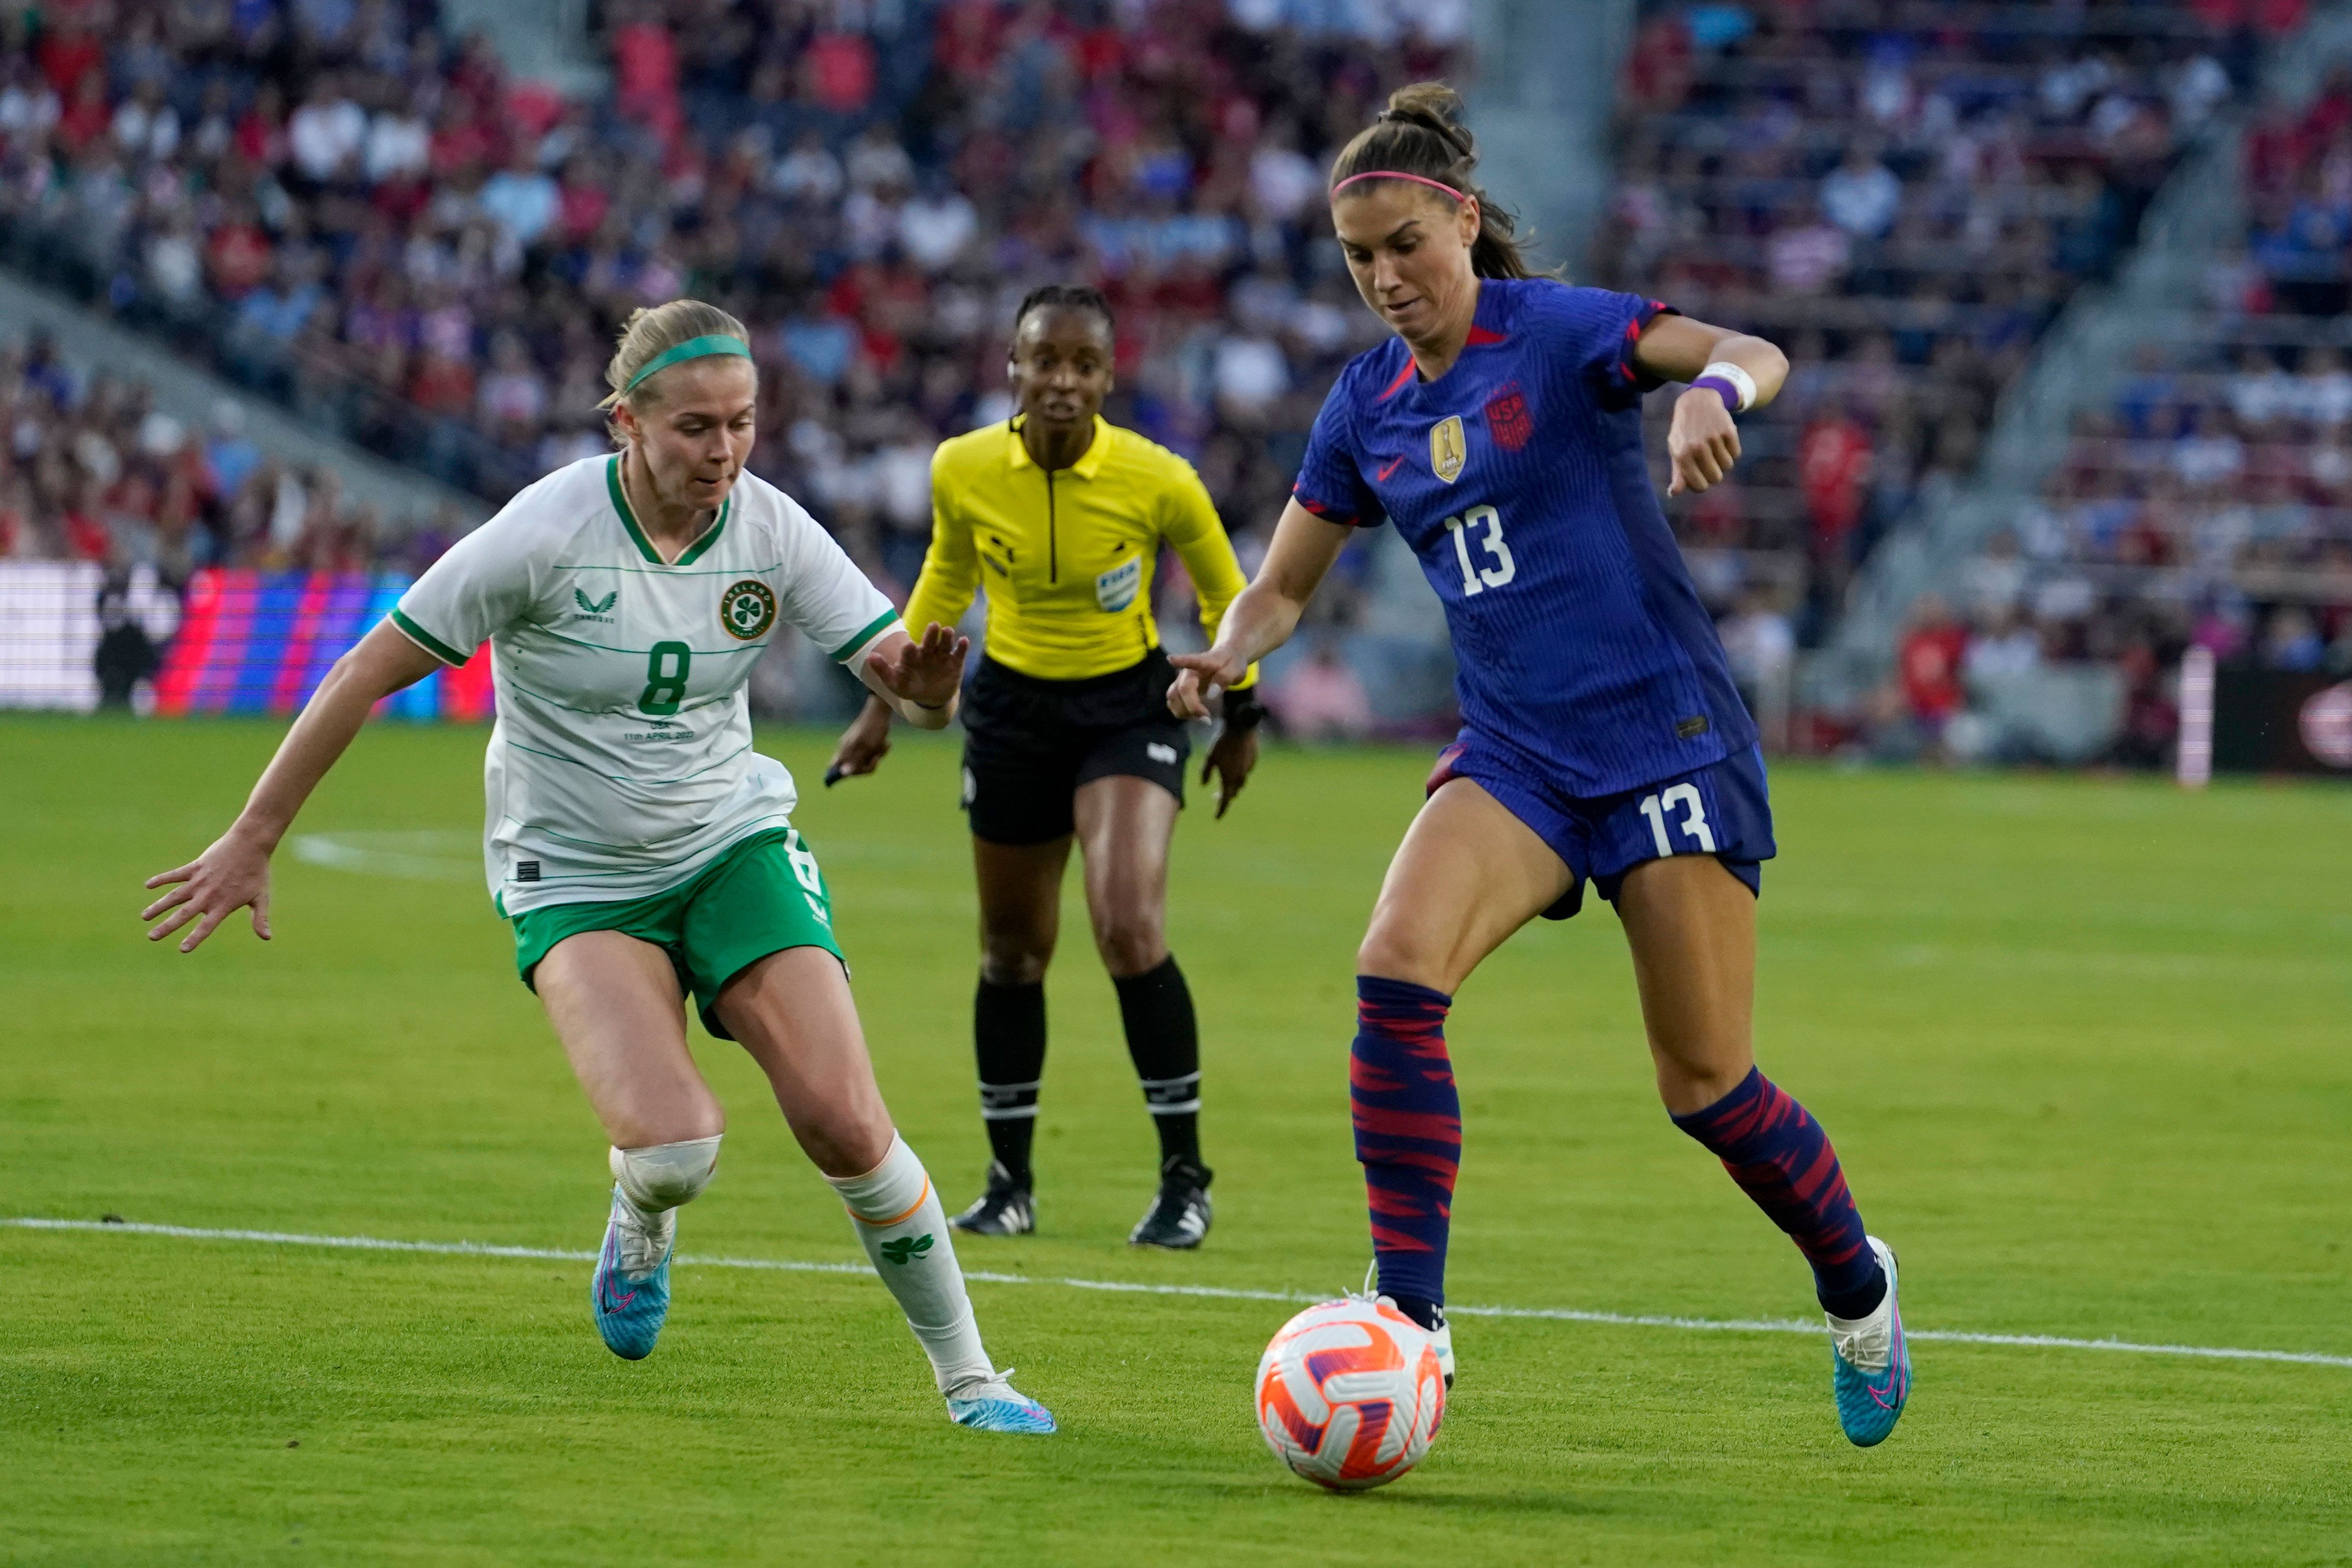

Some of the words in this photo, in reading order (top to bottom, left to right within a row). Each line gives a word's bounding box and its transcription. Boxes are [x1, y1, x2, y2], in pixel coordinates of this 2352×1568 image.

[1444, 504, 1516, 597] 13
[724, 584, 771, 604] IRELAND
[637, 641, 691, 716] 8
[1639, 782, 1716, 858] 13
